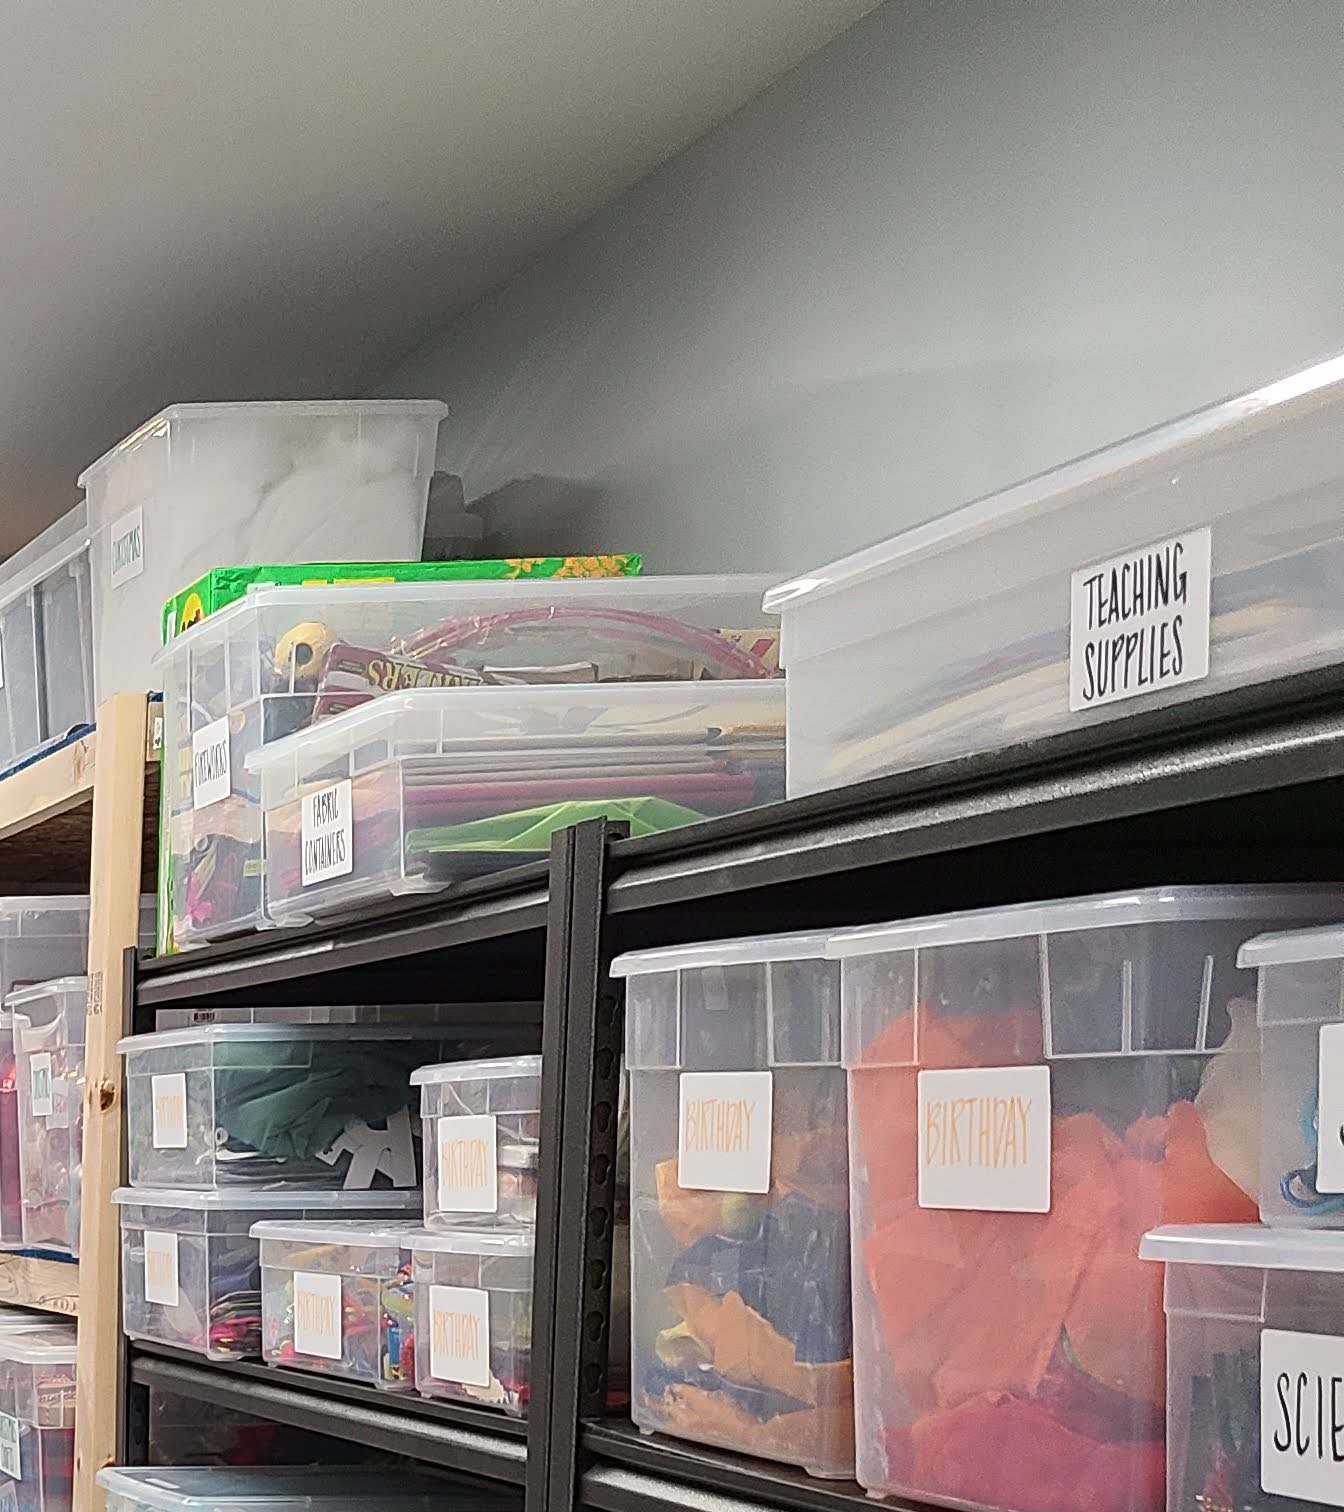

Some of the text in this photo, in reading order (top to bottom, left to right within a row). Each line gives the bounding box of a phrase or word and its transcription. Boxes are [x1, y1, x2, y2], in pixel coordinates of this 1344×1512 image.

[1083, 542, 1188, 631] TEACHING
[1083, 615, 1183, 700] SUPPLIES
[194, 740, 227, 787] FIREWORKS
[311, 787, 338, 829] FABRIC
[304, 828, 346, 873] CONTAINERS
[685, 1099, 754, 1153] BIRTHDAY
[925, 1096, 1032, 1169] BIRTHDAY
[1274, 1372, 1344, 1462] SCIE
